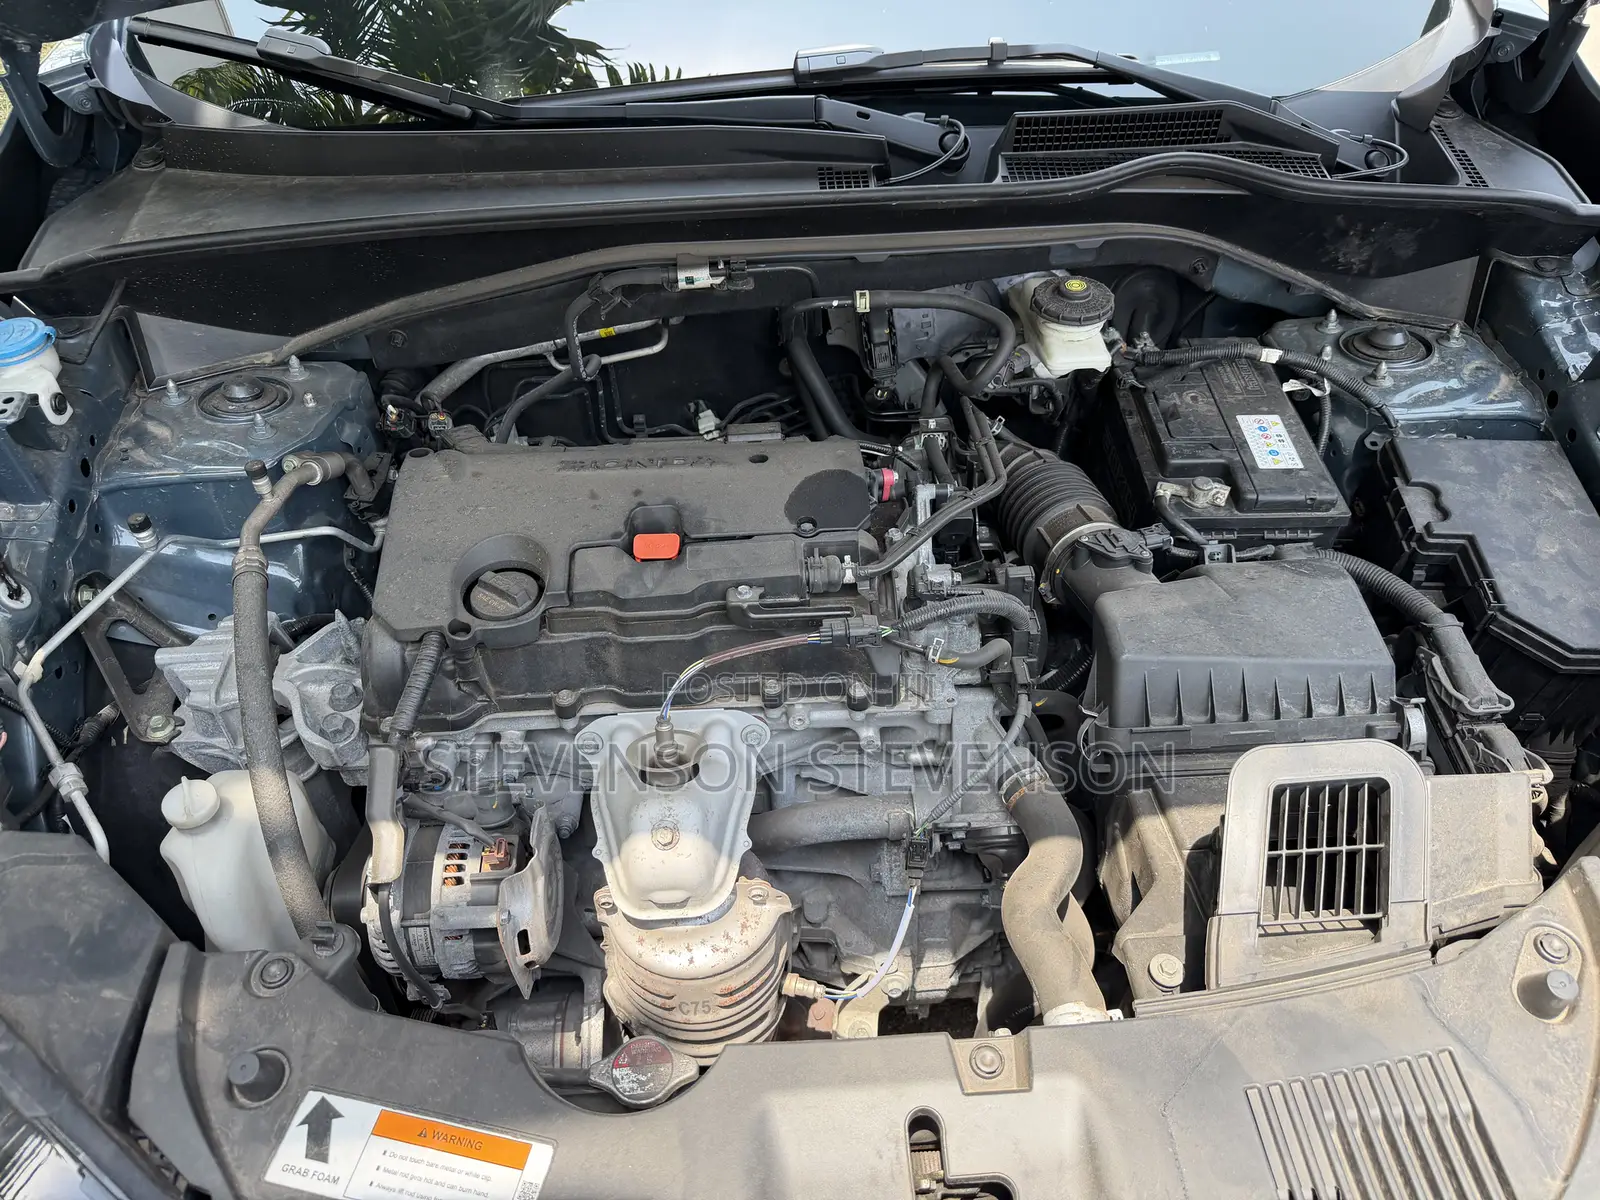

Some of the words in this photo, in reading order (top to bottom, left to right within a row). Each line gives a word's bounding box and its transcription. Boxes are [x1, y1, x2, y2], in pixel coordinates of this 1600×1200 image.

[678, 1001, 712, 1016] C75
[431, 1129, 484, 1151] WARNING
[409, 1156, 425, 1164] touch
[440, 1163, 456, 1172] metal
[281, 1163, 310, 1178] GRAB
[311, 1170, 340, 1185] FOAM
[382, 1166, 399, 1176] Metal
[423, 1176, 434, 1184] hot
[434, 1180, 445, 1188] and
[458, 1185, 473, 1194] burn
[375, 1182, 397, 1193] Always
[405, 1190, 416, 1198] rod
